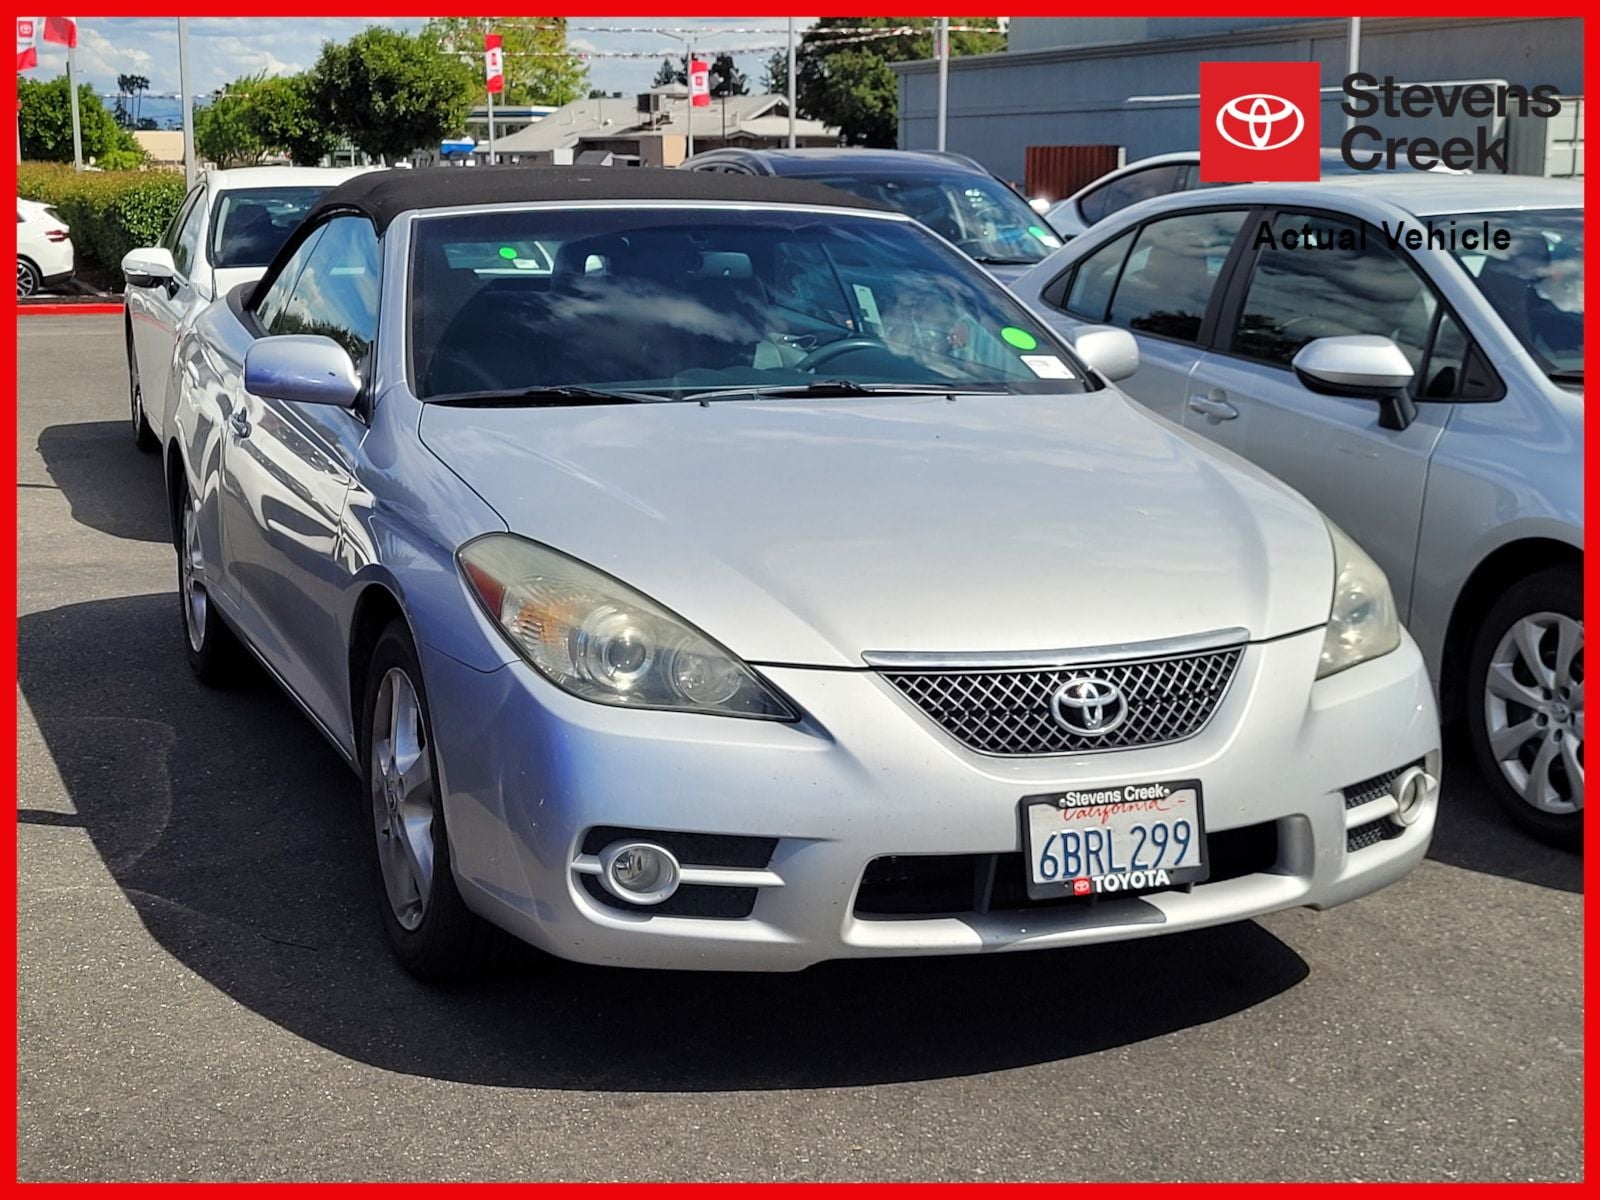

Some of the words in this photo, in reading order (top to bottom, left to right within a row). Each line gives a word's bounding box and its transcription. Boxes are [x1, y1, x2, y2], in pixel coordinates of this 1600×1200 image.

[1066, 789, 1121, 808] Stevens
[1124, 783, 1164, 803] Creek
[1039, 818, 1191, 881] 6BRL299
[1091, 869, 1171, 893] TOYOTA
